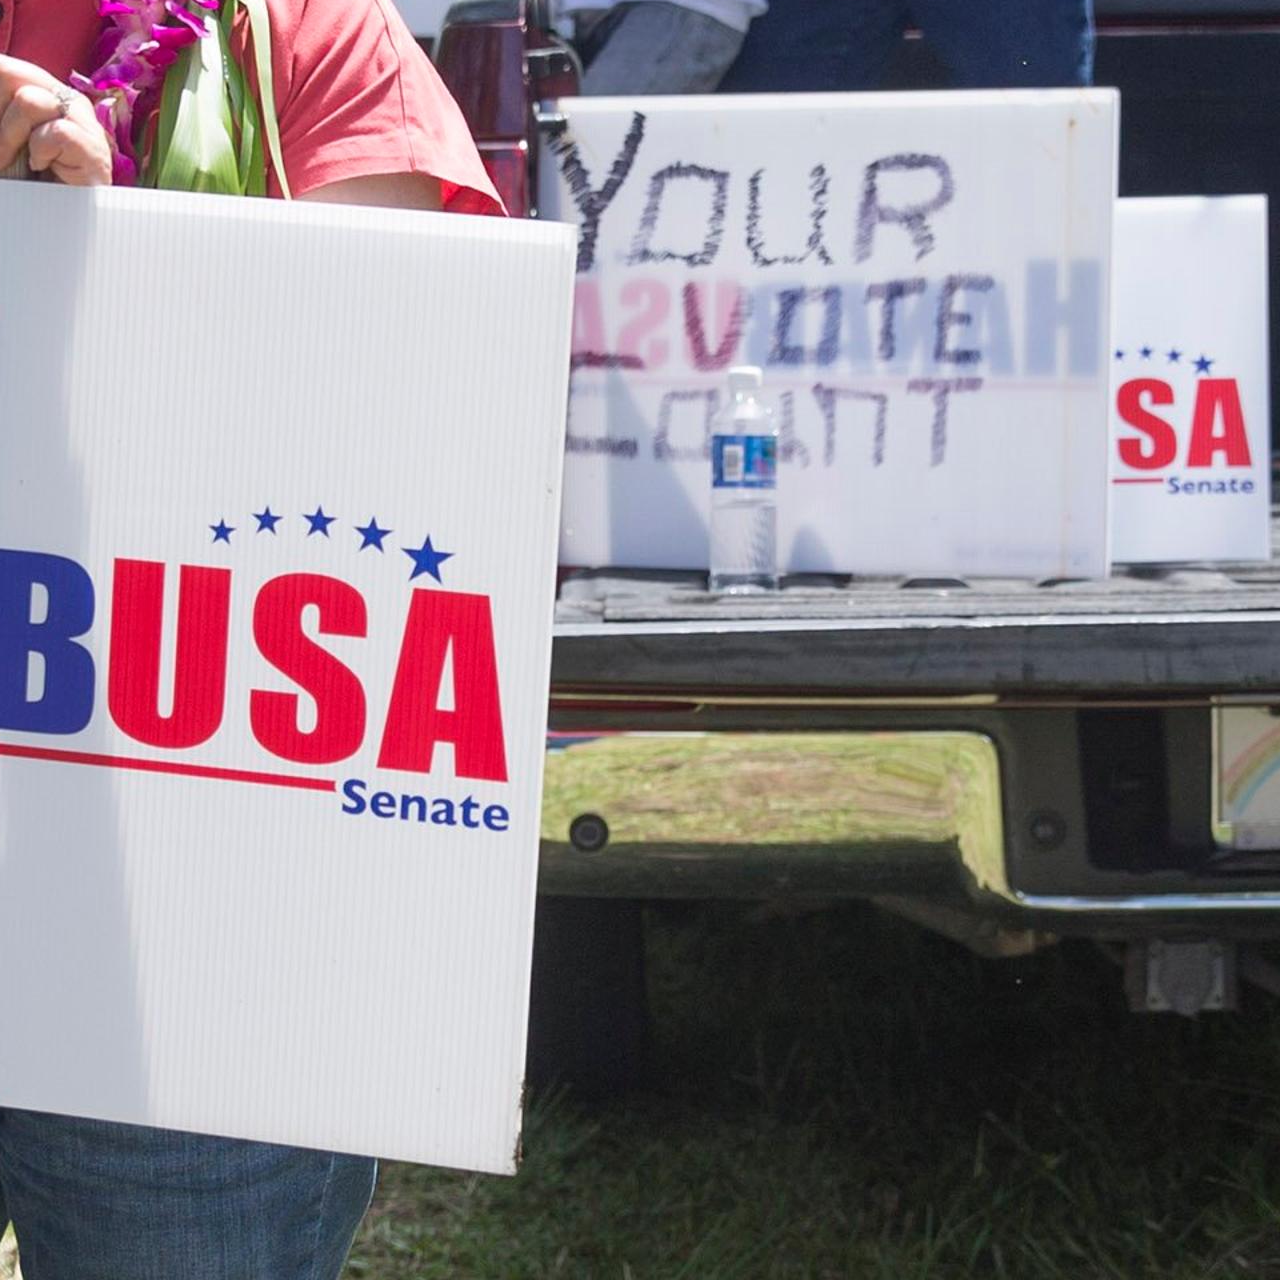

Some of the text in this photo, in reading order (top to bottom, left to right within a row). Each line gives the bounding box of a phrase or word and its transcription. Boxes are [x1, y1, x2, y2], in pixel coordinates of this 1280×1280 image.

[546, 111, 954, 272] YOUR
[1168, 477, 1255, 495] Senate
[341, 779, 510, 831] Senate
